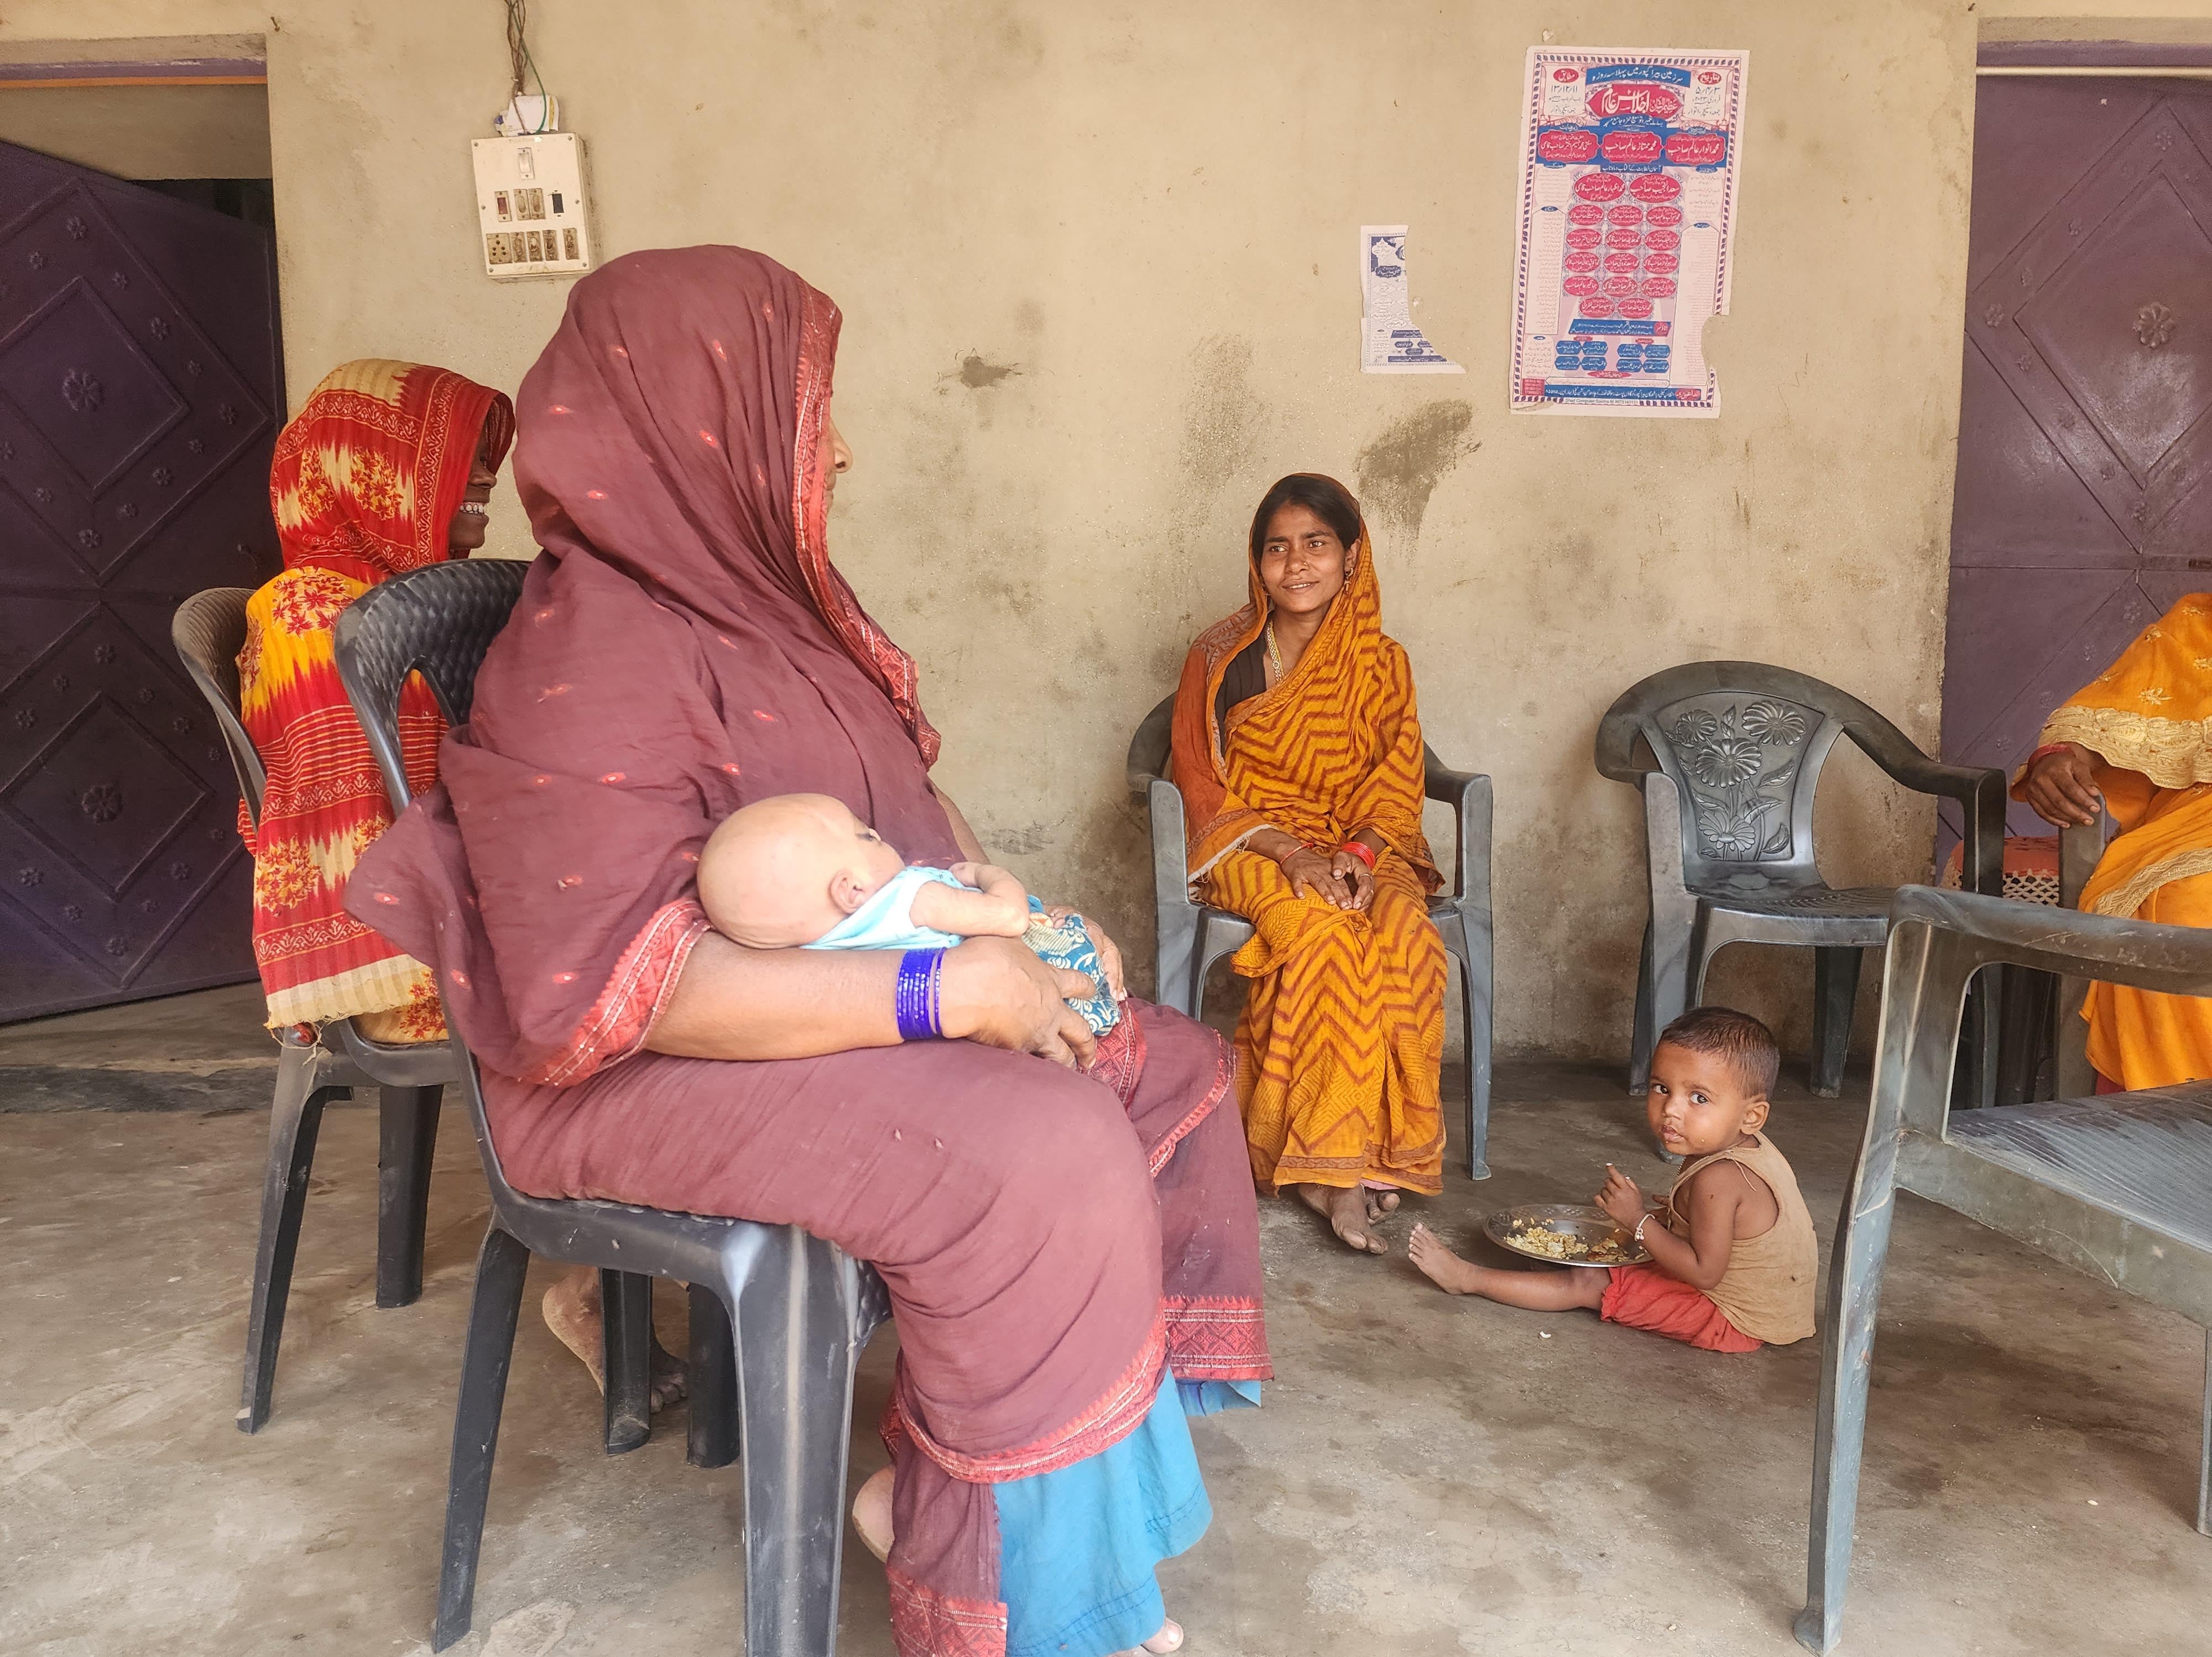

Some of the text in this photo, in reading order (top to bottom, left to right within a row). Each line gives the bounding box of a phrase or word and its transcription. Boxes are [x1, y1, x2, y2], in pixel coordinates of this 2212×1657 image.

[1558, 70, 1575, 81] مطابق
[1615, 68, 1626, 79] پہلا
[1627, 67, 1639, 76] میں
[1605, 138, 1657, 153] محمد ممتاز عالم صاحب
[1668, 141, 1720, 157] محمد انوار عالم صاحب
[1584, 184, 1600, 194] صاحب
[1630, 185, 1652, 195] صاحب
